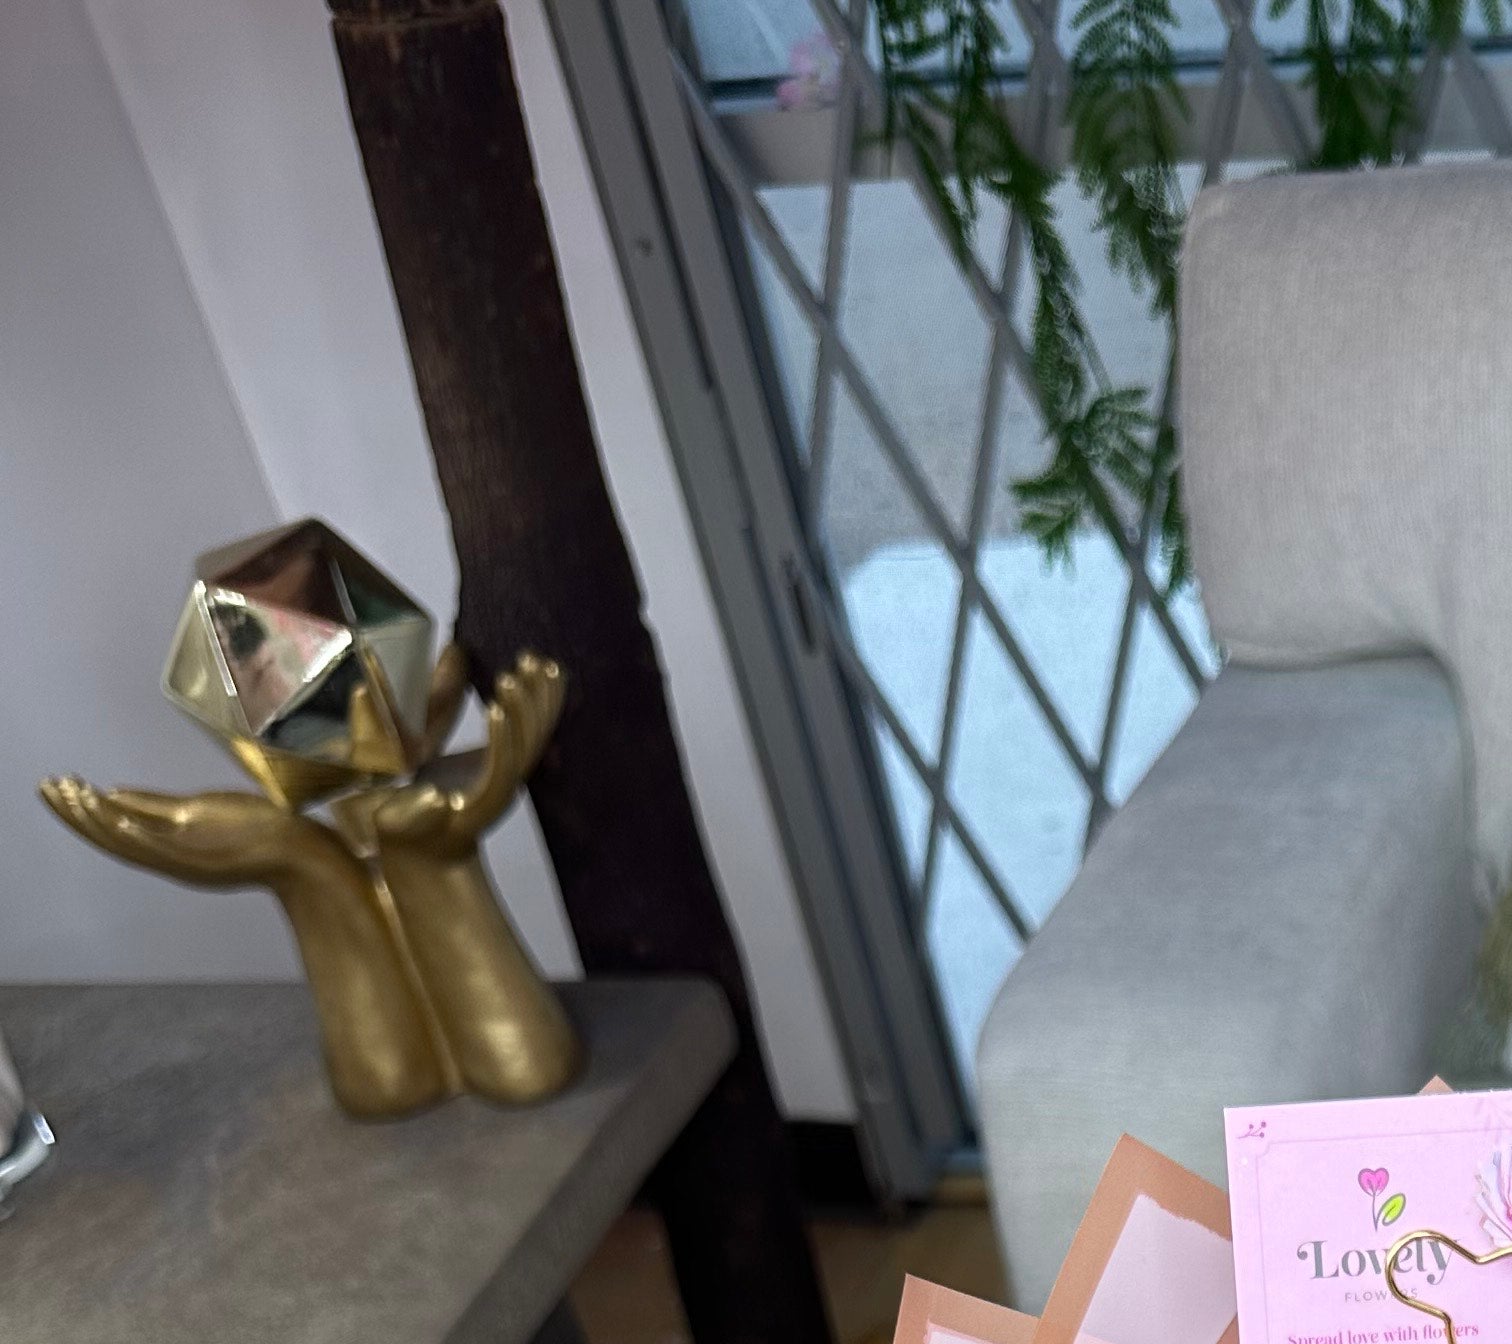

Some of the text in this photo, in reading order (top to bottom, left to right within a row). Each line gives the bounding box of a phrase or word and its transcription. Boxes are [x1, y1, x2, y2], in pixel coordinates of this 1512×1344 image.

[1297, 1238, 1461, 1285] Lovely
[1345, 1288, 1418, 1303] FLOWS
[1347, 1331, 1380, 1344] love
[1384, 1326, 1418, 1342] with
[1423, 1324, 1479, 1340] floers
